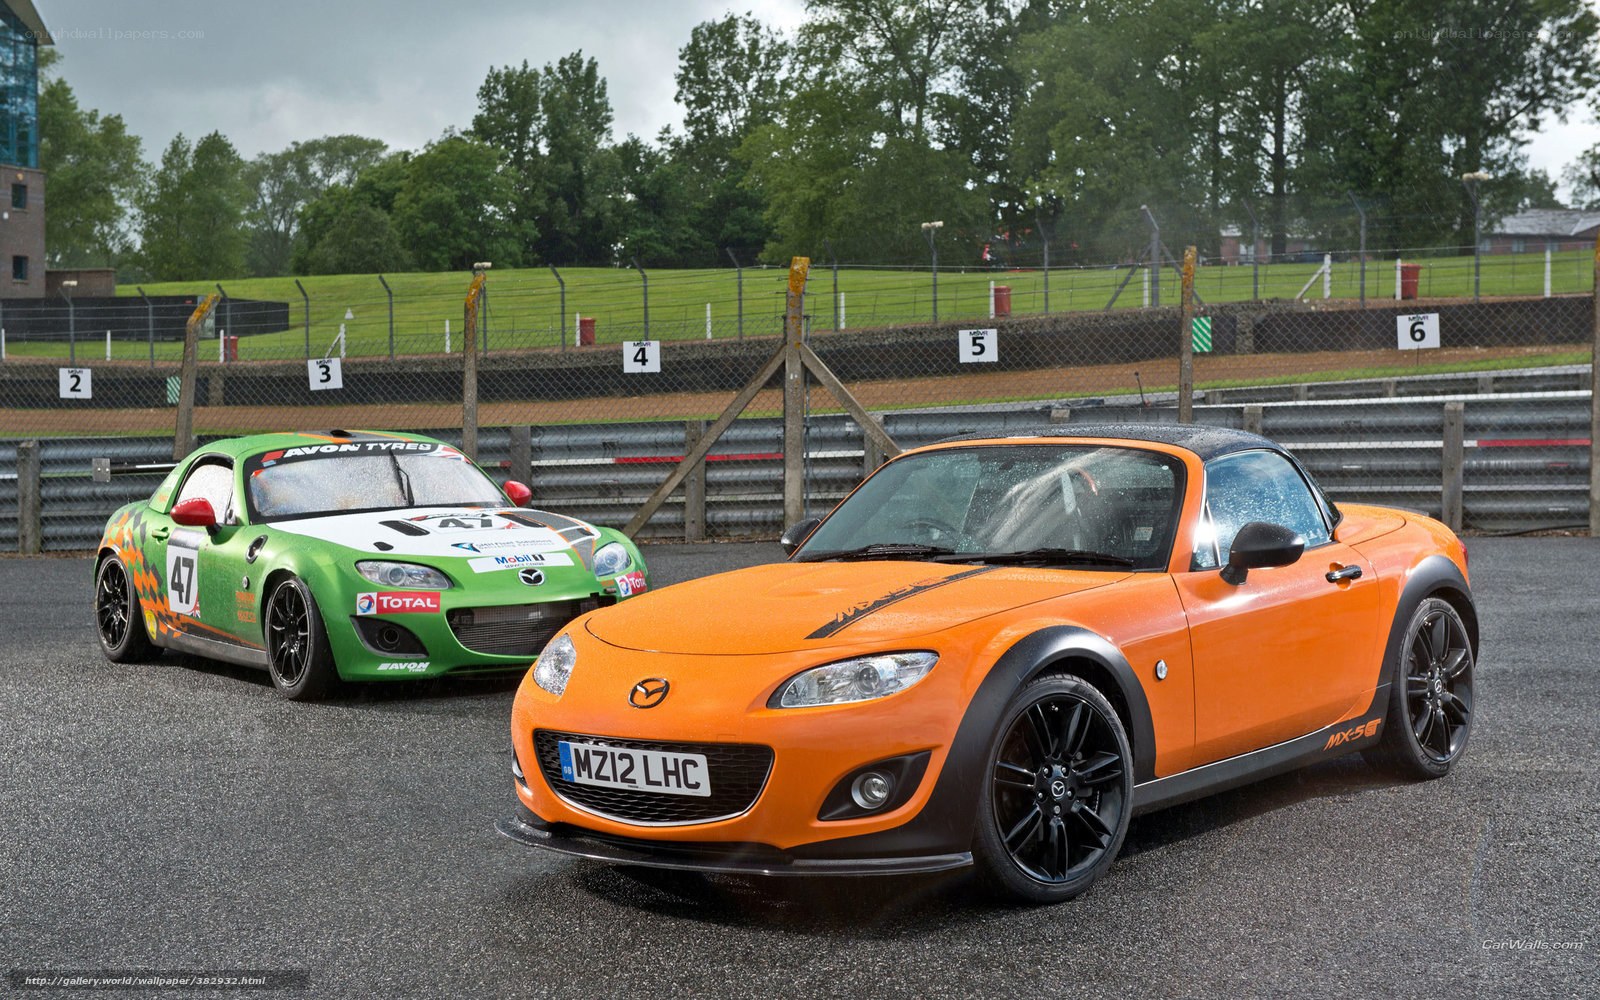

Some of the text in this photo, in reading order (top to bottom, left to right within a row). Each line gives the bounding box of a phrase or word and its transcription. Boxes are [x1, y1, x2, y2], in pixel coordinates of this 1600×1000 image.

[1410, 320, 1426, 342] 6
[972, 336, 985, 356] 5
[633, 347, 648, 366] 4
[319, 364, 331, 383] 3
[70, 374, 81, 392] 2
[283, 442, 432, 458] AVON TYRES
[495, 554, 532, 564] Mobil
[170, 555, 195, 605] 47
[379, 596, 437, 609] TOTAL
[389, 662, 430, 670] AVON
[563, 766, 572, 775] GB
[574, 748, 701, 790] MZ12 LHC
